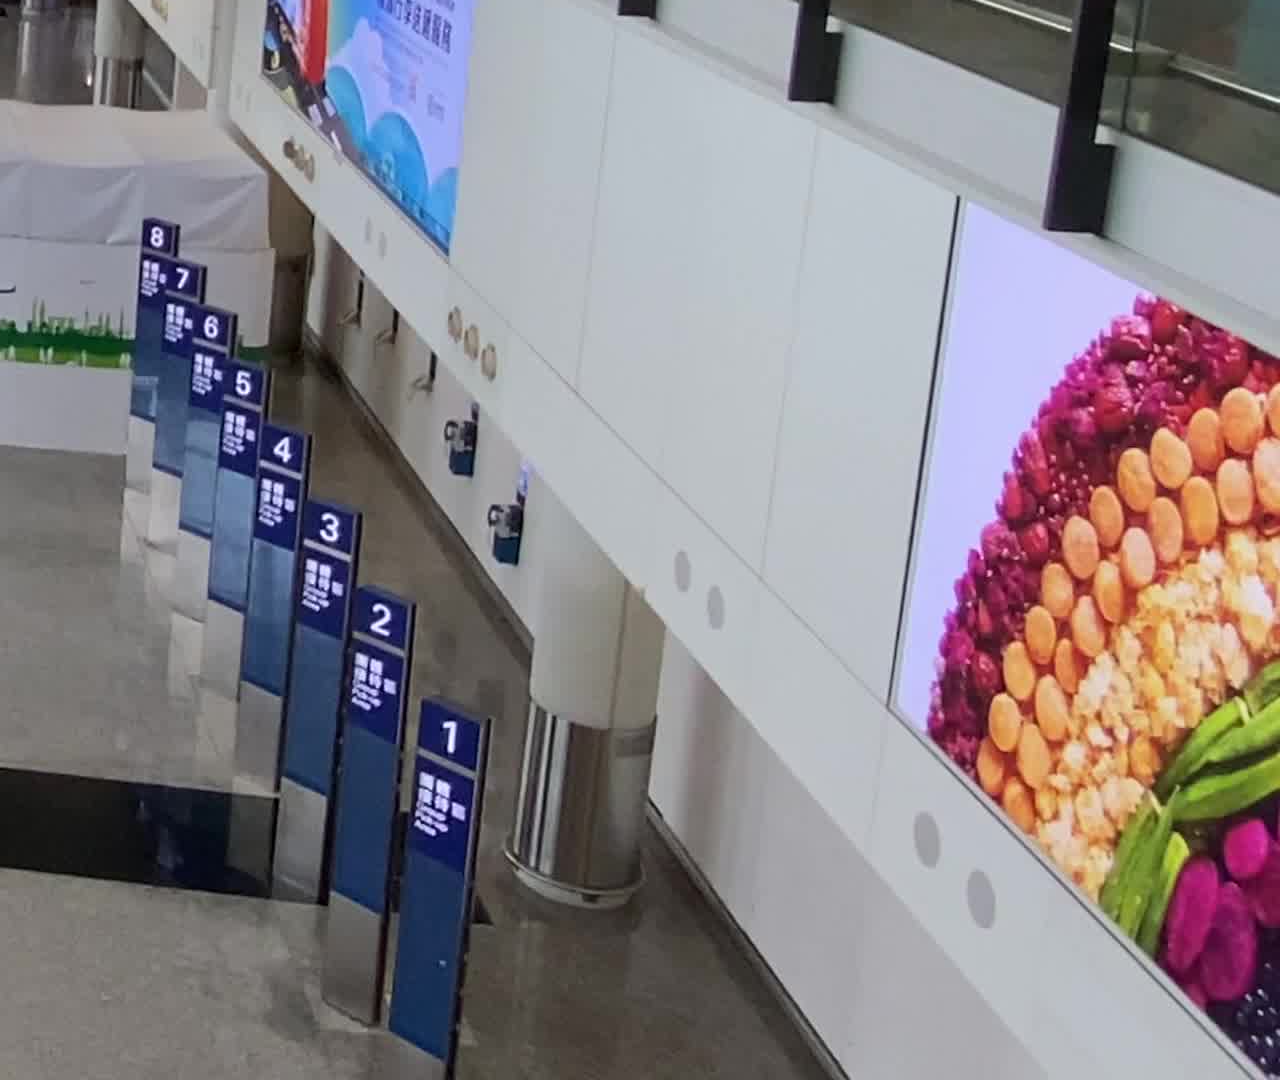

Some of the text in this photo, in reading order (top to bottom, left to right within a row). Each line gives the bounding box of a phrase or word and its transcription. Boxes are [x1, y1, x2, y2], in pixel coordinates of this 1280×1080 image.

[150, 226, 164, 248] 8
[176, 267, 189, 289] 7
[203, 315, 219, 339] 6
[235, 370, 251, 396] 5
[273, 437, 292, 463] 4
[319, 513, 340, 542] 3
[370, 603, 391, 636] 2
[442, 721, 457, 753] 1
